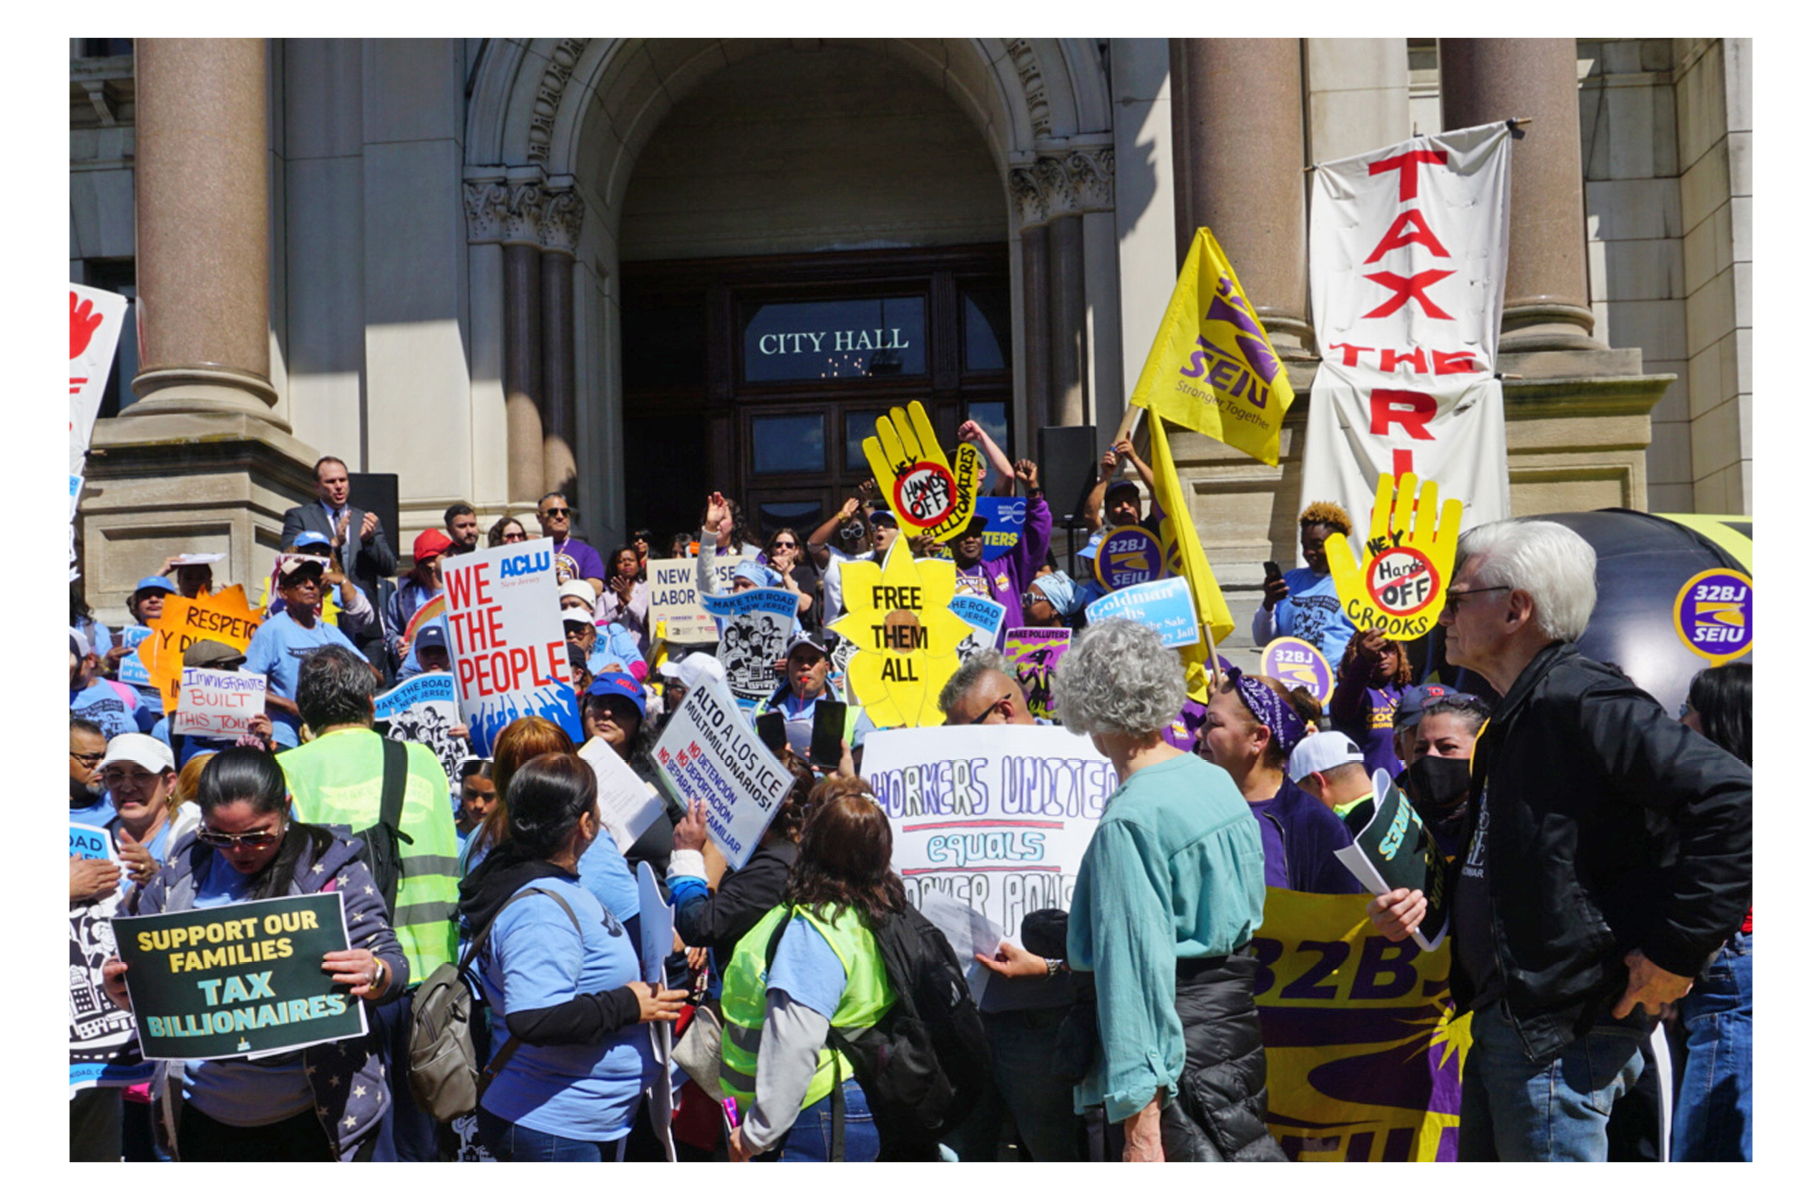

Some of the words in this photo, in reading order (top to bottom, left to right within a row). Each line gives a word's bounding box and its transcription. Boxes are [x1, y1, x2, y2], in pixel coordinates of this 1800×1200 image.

[1362, 149, 1459, 321] TAX
[759, 331, 827, 355] CITY
[834, 328, 910, 352] HALL
[1329, 342, 1481, 376] THE
[1179, 349, 1270, 409] SEIU
[1175, 379, 1225, 414] Stronger
[1225, 401, 1270, 431] Together
[892, 455, 918, 481] HEY
[903, 470, 949, 502] HANDS
[981, 531, 1019, 547] TERS
[1108, 537, 1148, 554] 32BJ
[1366, 529, 1404, 557] HEY
[500, 551, 551, 579] ACLU
[657, 568, 691, 585] NEW
[444, 562, 493, 610] WE
[1112, 571, 1150, 587] SEIU
[1382, 577, 1430, 606] OFF
[651, 588, 696, 606] LABOR
[713, 598, 742, 609] MAKE
[743, 593, 766, 602] THE
[766, 592, 795, 606] ROAD
[872, 585, 922, 611] FREE
[1089, 588, 1174, 618] Goldman
[1694, 585, 1747, 601] 32BJ
[951, 600, 968, 609] HE
[968, 601, 999, 619] ROAD
[963, 611, 995, 627] JERSEY
[1347, 598, 1429, 636] CROOKS
[161, 629, 174, 651] Y
[449, 605, 507, 655] THE
[871, 624, 928, 650] THEM
[1008, 630, 1027, 639] MAKE
[1028, 630, 1070, 639] POLLUTERS
[1693, 627, 1745, 643] SEIU
[881, 657, 919, 682] ALL
[1275, 649, 1314, 664] 32BJ
[458, 641, 571, 700] PEOPLE
[188, 688, 252, 708] BUILT
[400, 682, 421, 698] THE
[421, 679, 452, 689] ROAD
[420, 689, 451, 699] JERSEY
[176, 711, 211, 728] THIS
[212, 714, 251, 730] TOW
[692, 685, 725, 728] ALTO
[720, 723, 734, 743] A
[731, 734, 760, 772] LOS
[755, 764, 784, 798] ICE
[657, 746, 671, 766] NO
[684, 699, 773, 813] MULTIMILLONARIOS!
[687, 740, 702, 761] NO
[697, 753, 738, 806] DETENCIÓN
[675, 748, 689, 768] NO
[685, 761, 735, 825] DEPORTACIÓN
[137, 917, 258, 952] SUPPORT
[263, 910, 319, 933] OUR
[168, 938, 294, 974] FAMILIES
[197, 970, 276, 1007] TAX
[146, 993, 347, 1038] BILLIONAIRES
